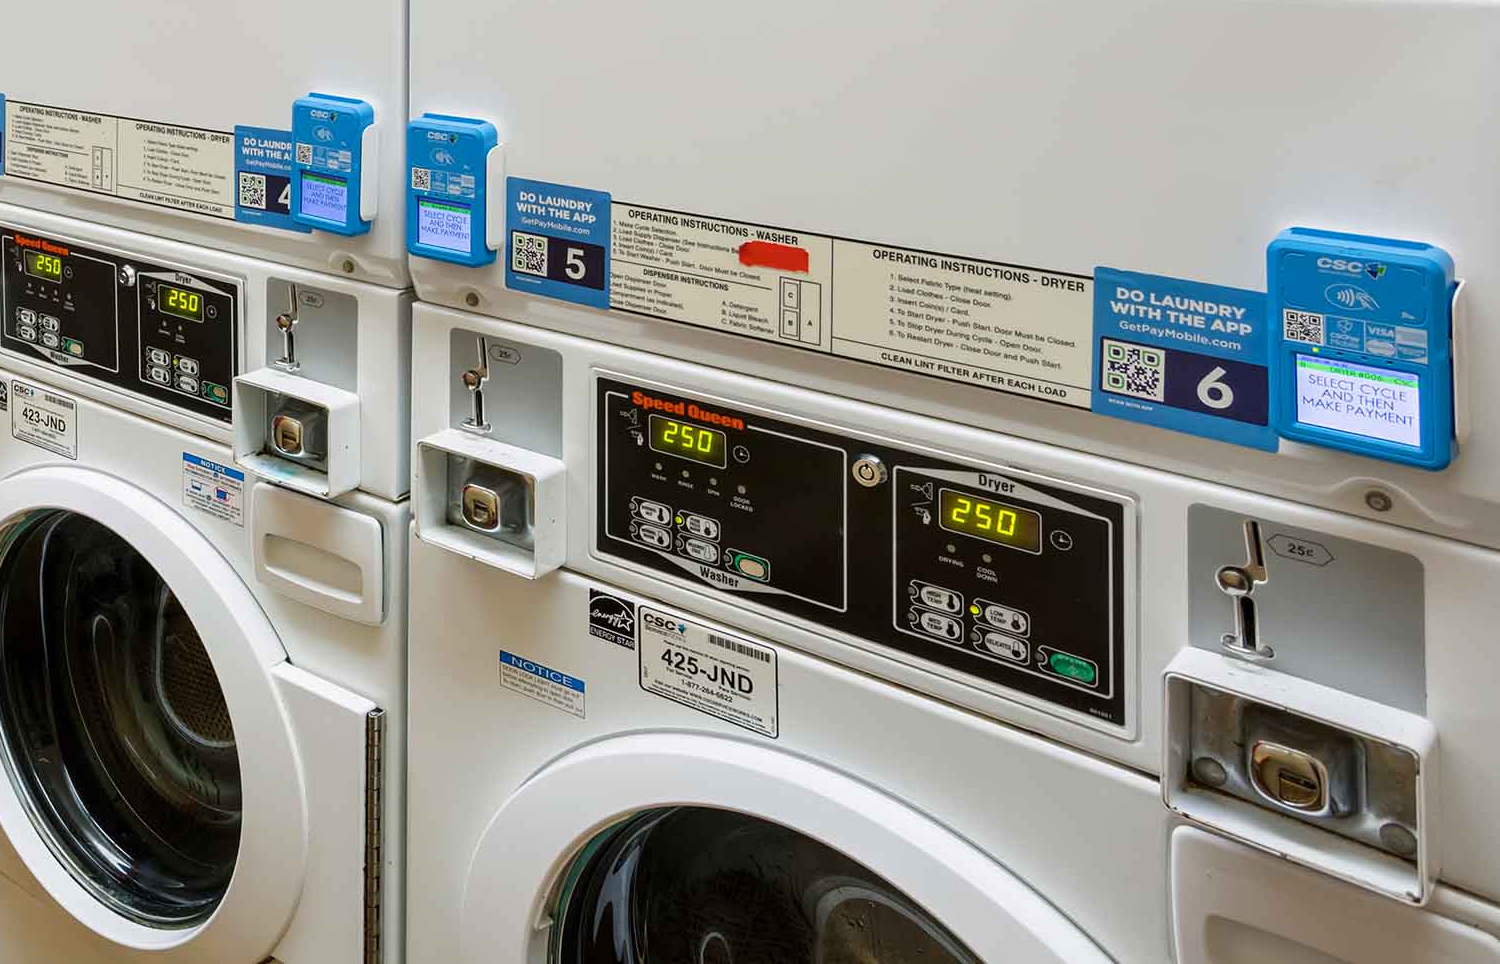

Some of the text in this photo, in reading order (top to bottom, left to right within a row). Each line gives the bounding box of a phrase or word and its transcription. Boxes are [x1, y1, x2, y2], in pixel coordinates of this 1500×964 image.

[136, 123, 230, 143] OPERATING INSTRUCTIONS DRYER
[243, 137, 292, 150] DO LAUNDR
[242, 146, 263, 156] WITH
[265, 149, 283, 159] THE
[278, 183, 290, 210] 4
[520, 191, 592, 212] DO LAUNDRY
[516, 202, 596, 224] WITH THE APP
[521, 217, 590, 235] GetPayMobile.com
[628, 209, 798, 245] OPERATING INSTRUCTIONS WASHER
[36, 255, 61, 275] 250
[565, 247, 586, 280] 5
[715, 267, 730, 275] Must
[873, 249, 1085, 292] OPERATING INSTRUCTIONS DRYER
[1317, 257, 1364, 273] CSC
[643, 269, 729, 291] DISPENSER INSTRUCTIONS
[898, 275, 919, 284] Select
[921, 278, 942, 288] Fabric
[945, 282, 961, 291] Type
[963, 285, 982, 295] (heat
[169, 290, 198, 312] 250
[898, 286, 970, 304] Load Clothes Close
[898, 297, 917, 306] Insert
[1116, 286, 1246, 320] DO LAUNDRY
[729, 302, 758, 312] Detergent
[1110, 300, 1252, 336] WITH THE APP
[729, 320, 774, 334] Fabric Softener
[907, 310, 924, 319] Start
[926, 314, 945, 323] Dryer
[952, 319, 970, 328] Push
[994, 326, 1013, 335] Door
[1014, 330, 1034, 339] Must
[1035, 334, 1045, 342] be
[907, 322, 923, 331] Stop
[924, 324, 944, 335] Dryer
[946, 329, 970, 340] During
[972, 334, 993, 344] Cycle
[999, 339, 1020, 349] Open
[1119, 320, 1241, 350] GetPayMobile.com
[1367, 326, 1395, 337] VISA
[907, 333, 932, 344] Restart
[934, 337, 953, 348] Dryer
[960, 344, 981, 353] Close
[983, 348, 1001, 357] Door
[1003, 353, 1018, 361] and
[1020, 355, 1039, 365] Push
[881, 352, 1067, 398] CLEAN LINT FILTER AFTER EACH LOAD
[14, 385, 30, 396] CSC
[1196, 366, 1234, 409] 6
[1308, 374, 1406, 402] SELECT CYCLE
[632, 391, 744, 430] Speed Queen
[1302, 396, 1413, 426] MAKE PAYMENT
[1321, 389, 1394, 411] AND THEN
[22, 407, 66, 432] 423-JND
[663, 421, 713, 453] 250
[201, 460, 226, 474] NOTICE
[979, 474, 1015, 493] Dryer
[952, 499, 1016, 536] 250
[938, 555, 964, 568] DRYING
[977, 566, 997, 576] COOL
[700, 566, 739, 588] Washer
[976, 572, 998, 583] DOWN
[644, 613, 677, 631] CSC
[990, 609, 1004, 618] LOW
[590, 627, 615, 642] ENERGY
[511, 657, 573, 687] NOTICE
[661, 648, 753, 694] 425-JND
